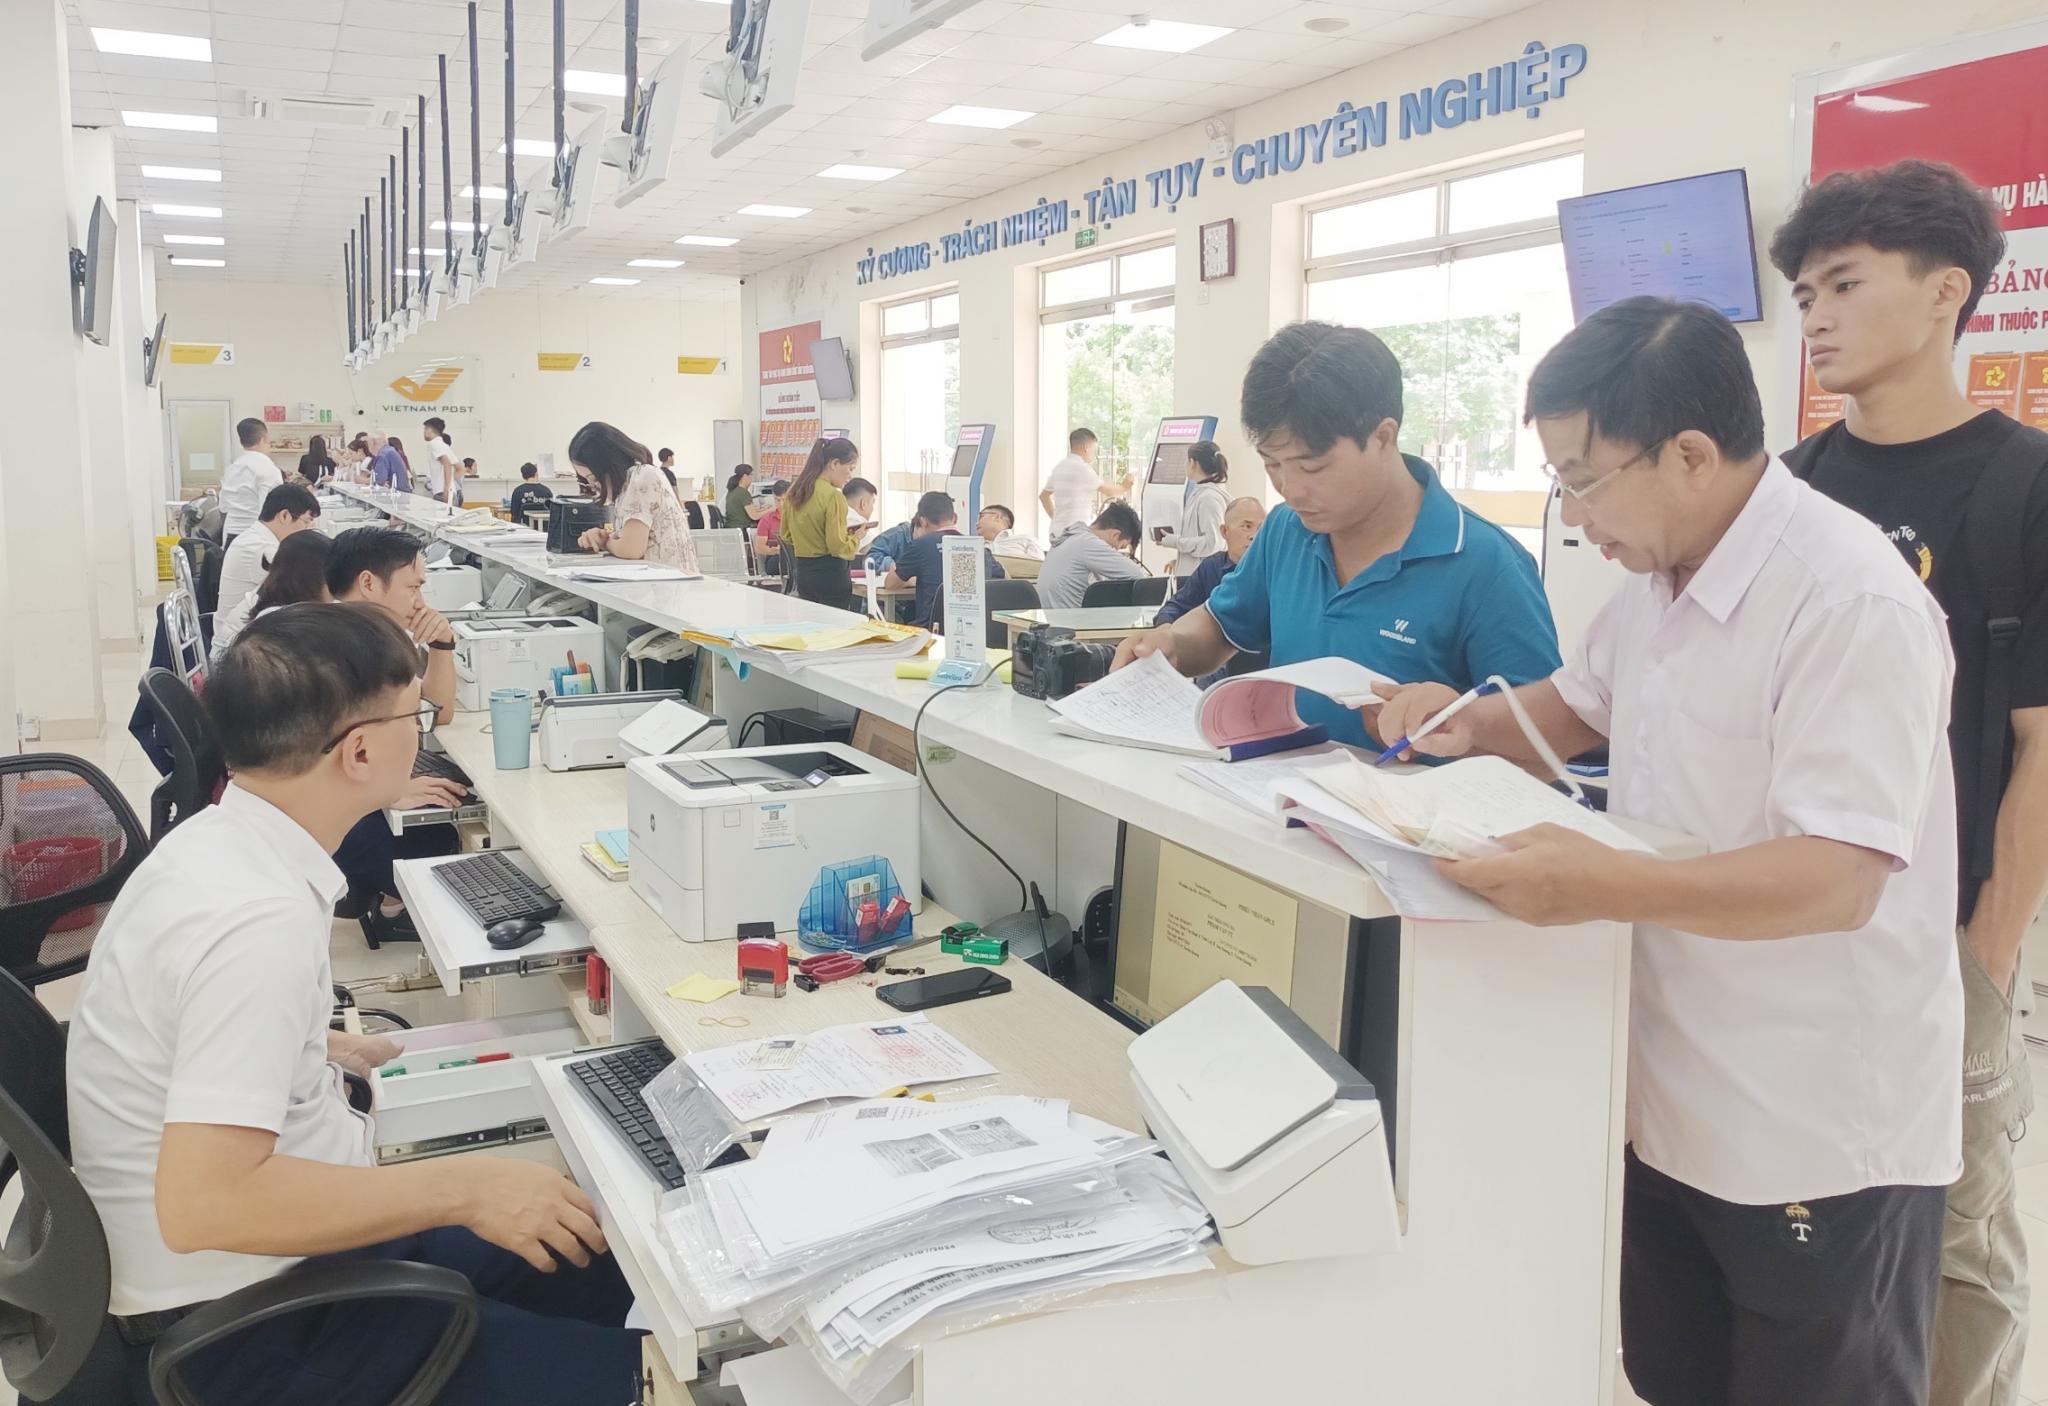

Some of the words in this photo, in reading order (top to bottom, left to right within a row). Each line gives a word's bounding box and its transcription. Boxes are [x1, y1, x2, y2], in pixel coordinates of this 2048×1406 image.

[857, 248, 875, 285] KỶ
[940, 220, 997, 264] TRÁCH
[1002, 197, 1068, 247] NHIỆM
[1084, 176, 1136, 230] TẬN
[1145, 157, 1205, 213] TỤY
[1232, 101, 1387, 185] CHUYÊN
[1400, 40, 1588, 140] NGHIỆP
[2000, 307, 2038, 334] THUỘC
[222, 350, 232, 361] 3
[582, 356, 591, 367] 2
[721, 361, 727, 371] 1
